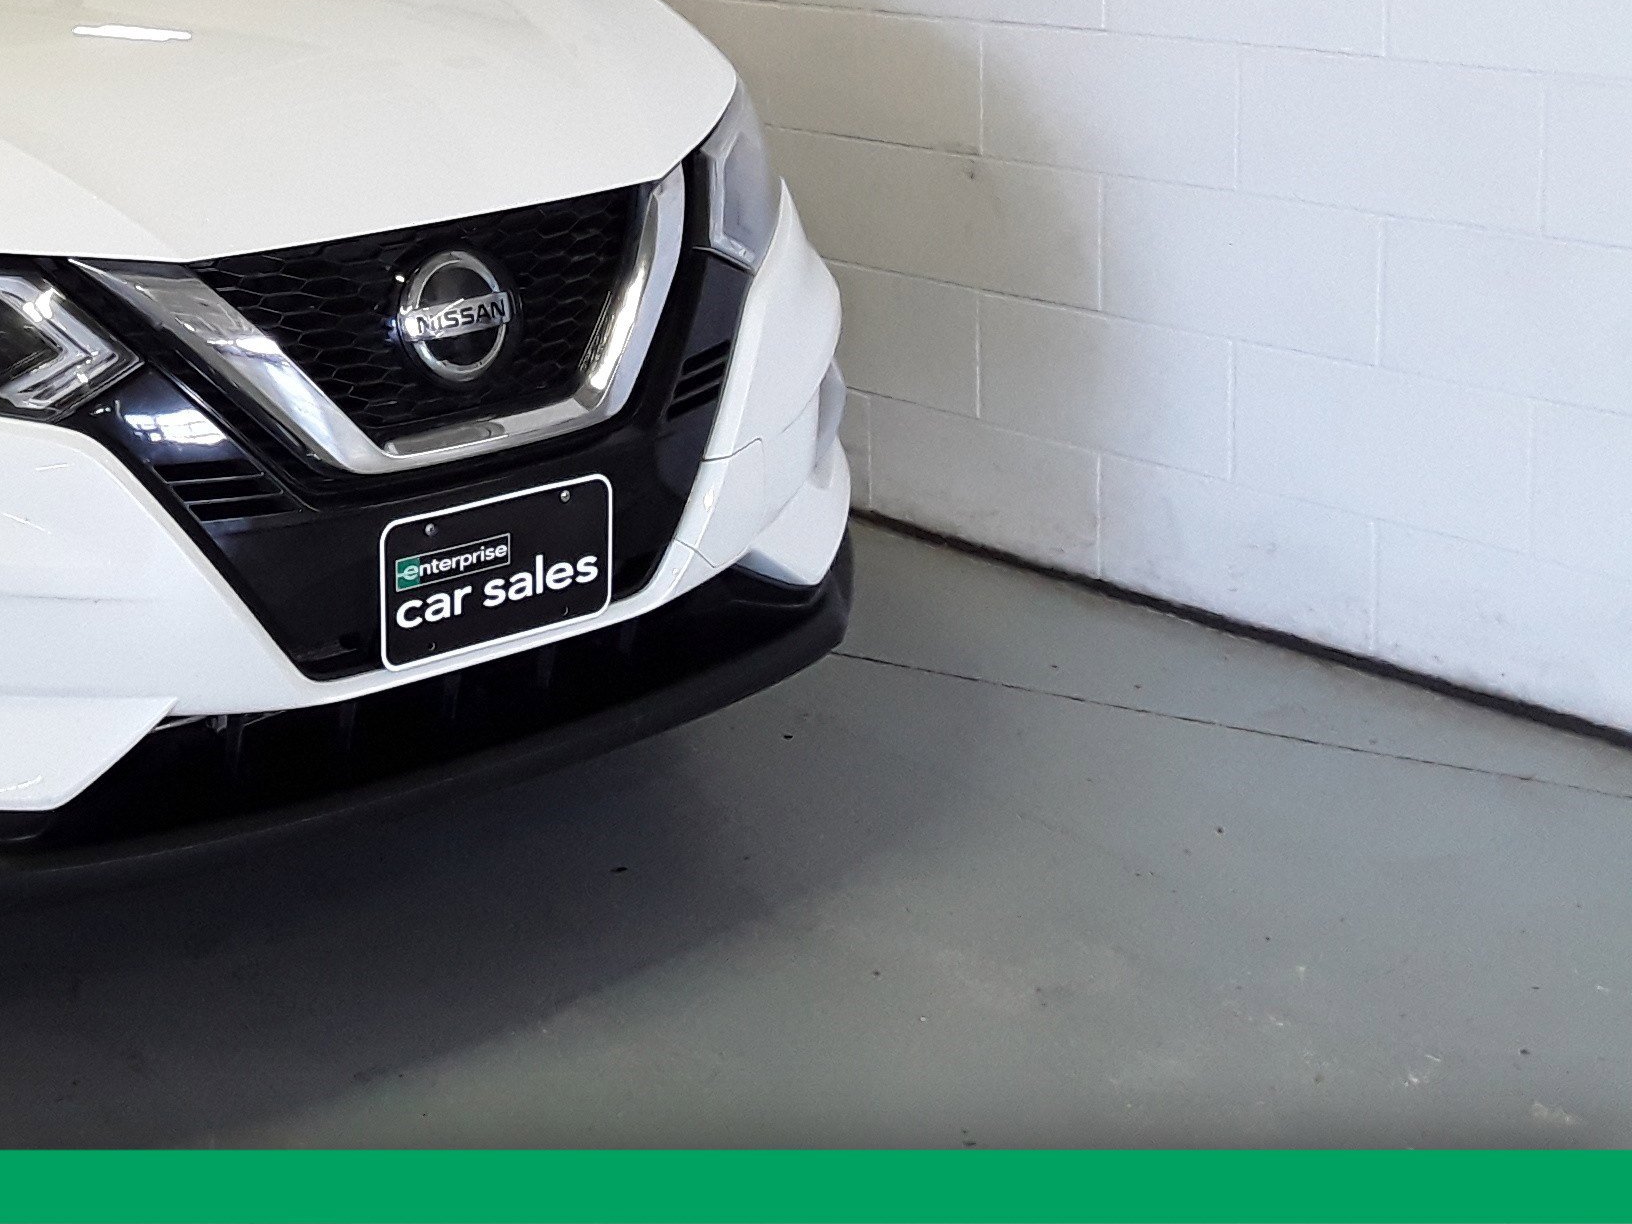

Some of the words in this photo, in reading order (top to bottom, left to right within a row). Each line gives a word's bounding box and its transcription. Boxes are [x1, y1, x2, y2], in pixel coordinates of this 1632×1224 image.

[416, 299, 506, 334] NISSAN
[402, 543, 508, 581] enterprise
[396, 585, 472, 629] car
[482, 554, 599, 607] sales
